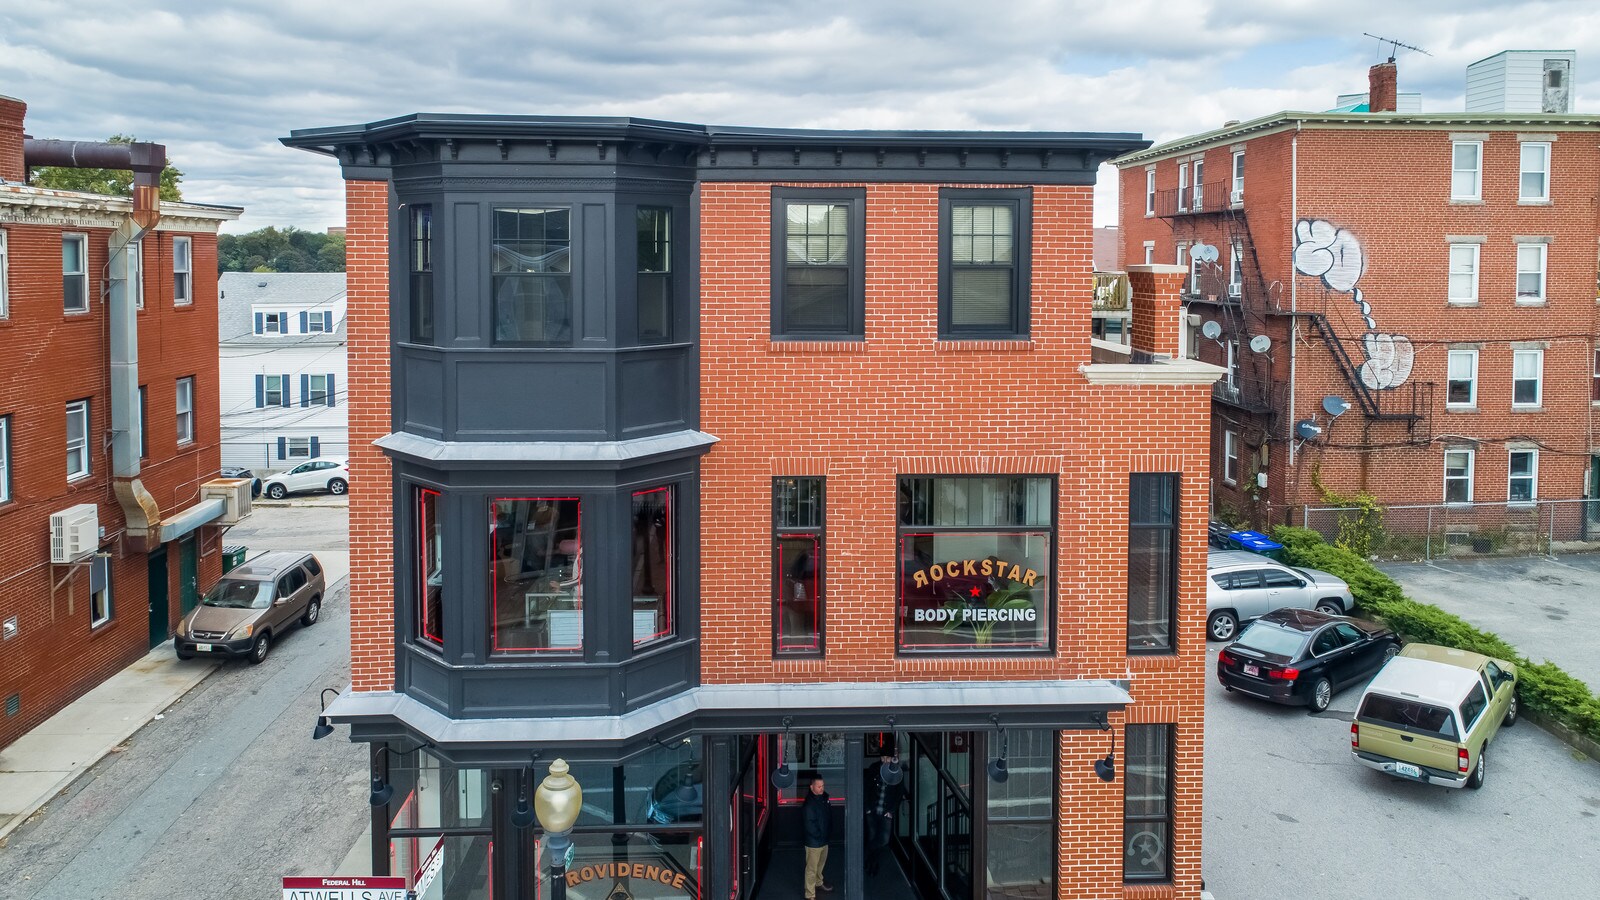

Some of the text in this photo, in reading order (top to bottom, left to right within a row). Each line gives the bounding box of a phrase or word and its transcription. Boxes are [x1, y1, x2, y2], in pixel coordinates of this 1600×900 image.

[914, 608, 1036, 622] BODY PIERCING
[565, 862, 687, 889] ROVIDENCE
[322, 878, 366, 886] FEDERAL HILL
[378, 891, 402, 900] AVE
